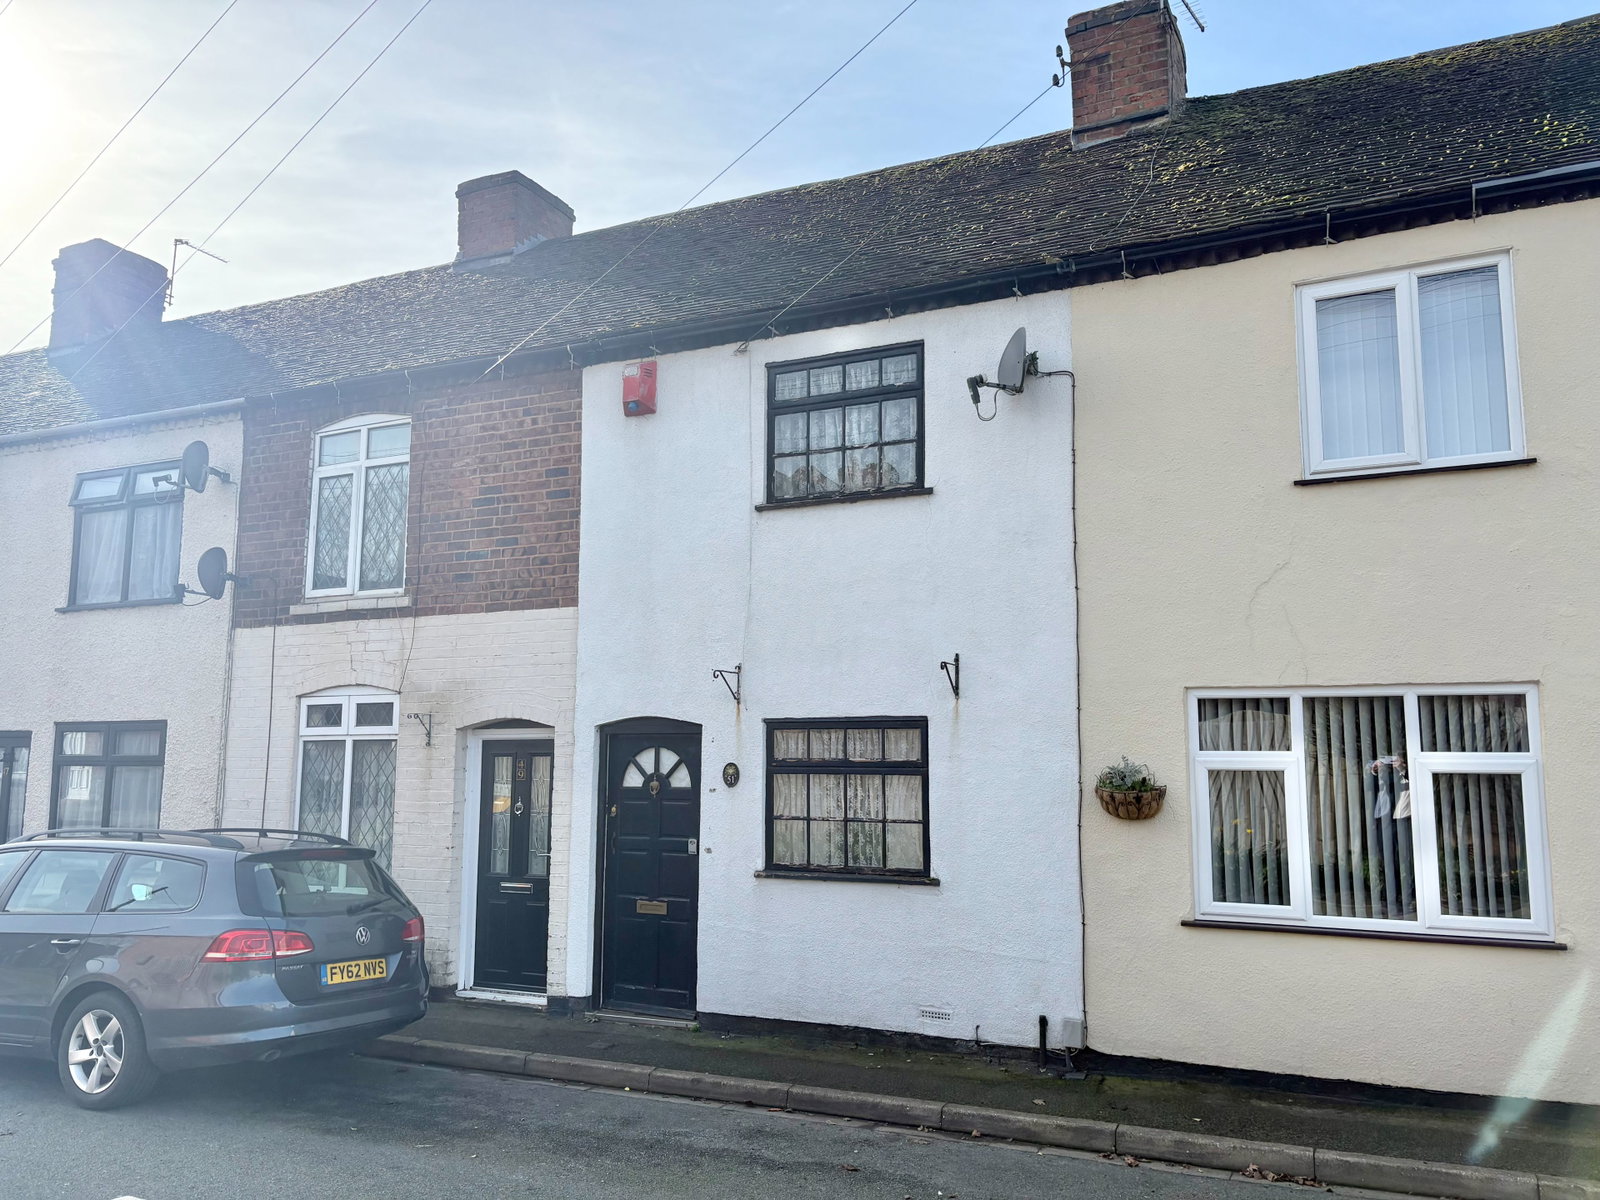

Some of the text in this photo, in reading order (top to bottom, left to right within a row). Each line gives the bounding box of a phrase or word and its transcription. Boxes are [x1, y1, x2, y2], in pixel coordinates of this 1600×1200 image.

[726, 775, 735, 784] 51
[329, 960, 384, 981] FY62 NVS
